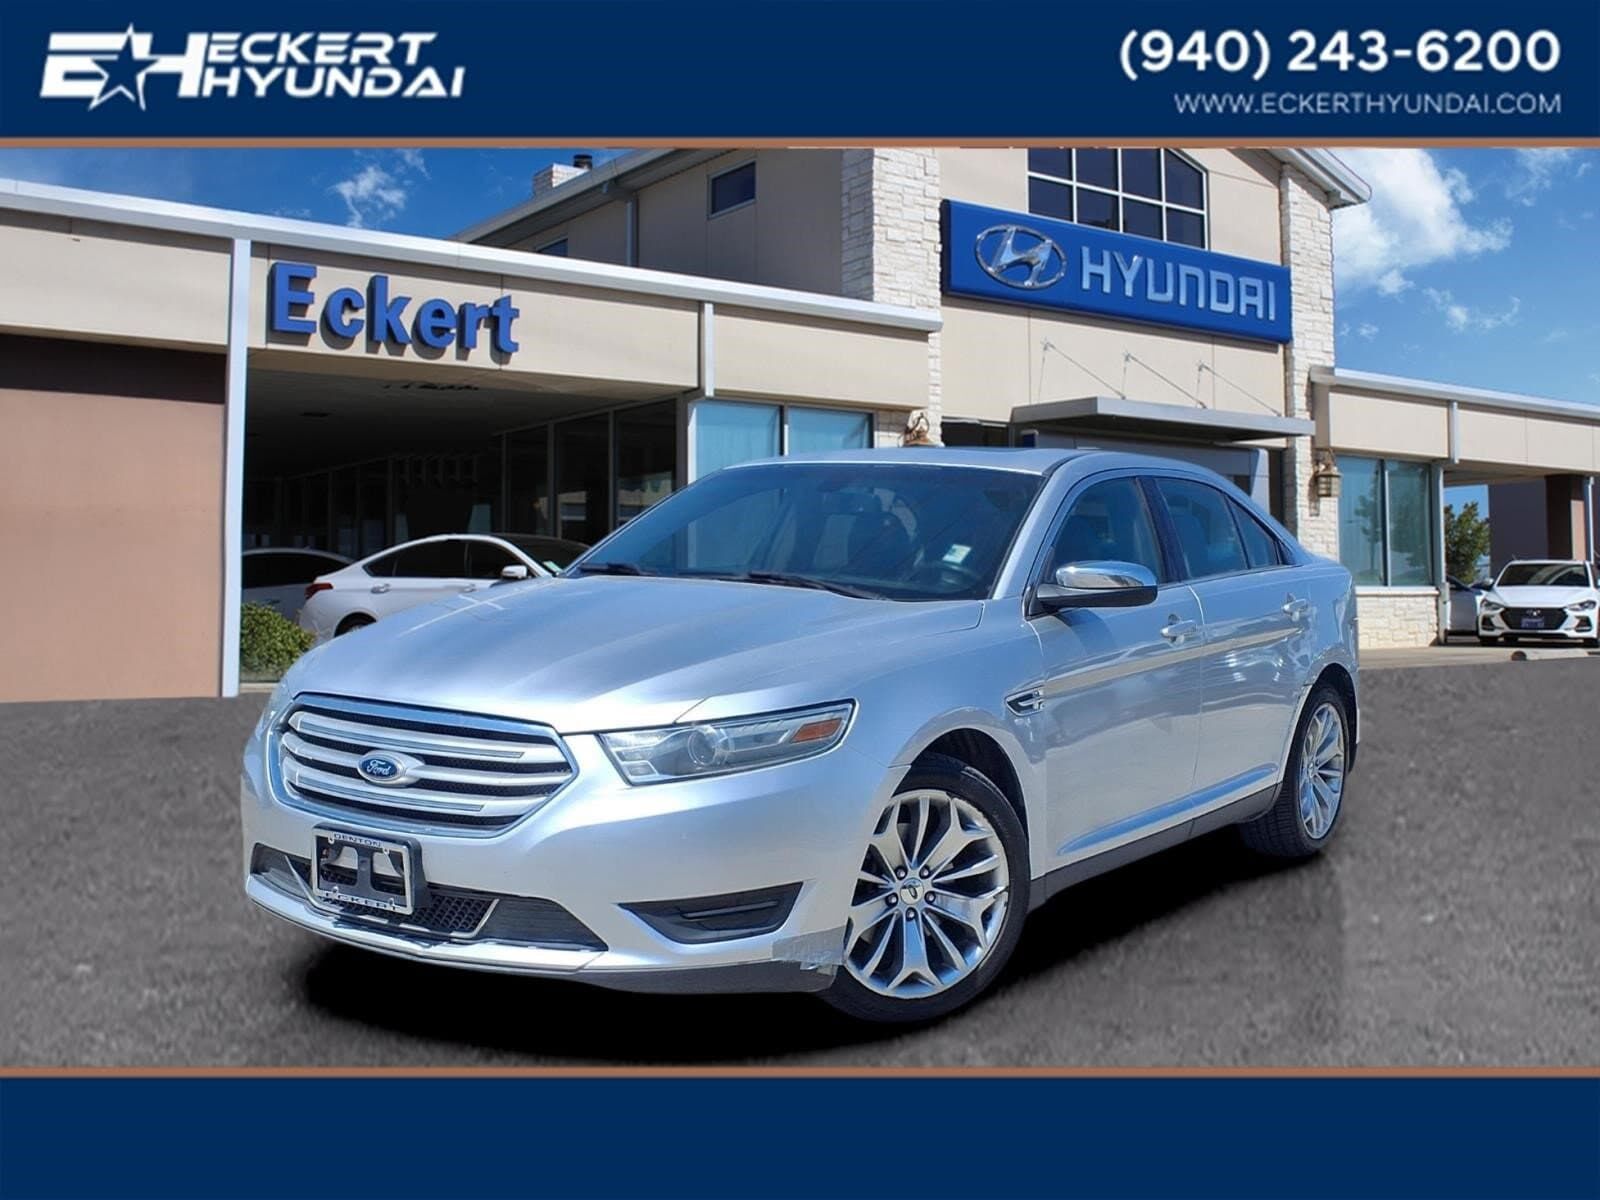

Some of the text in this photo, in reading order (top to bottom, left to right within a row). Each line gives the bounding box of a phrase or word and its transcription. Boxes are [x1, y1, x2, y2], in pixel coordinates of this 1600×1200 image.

[1081, 246, 1276, 321] HYUNDAI
[269, 261, 520, 356] Eckert
[366, 760, 391, 776] Ford
[333, 832, 382, 848] DENTON
